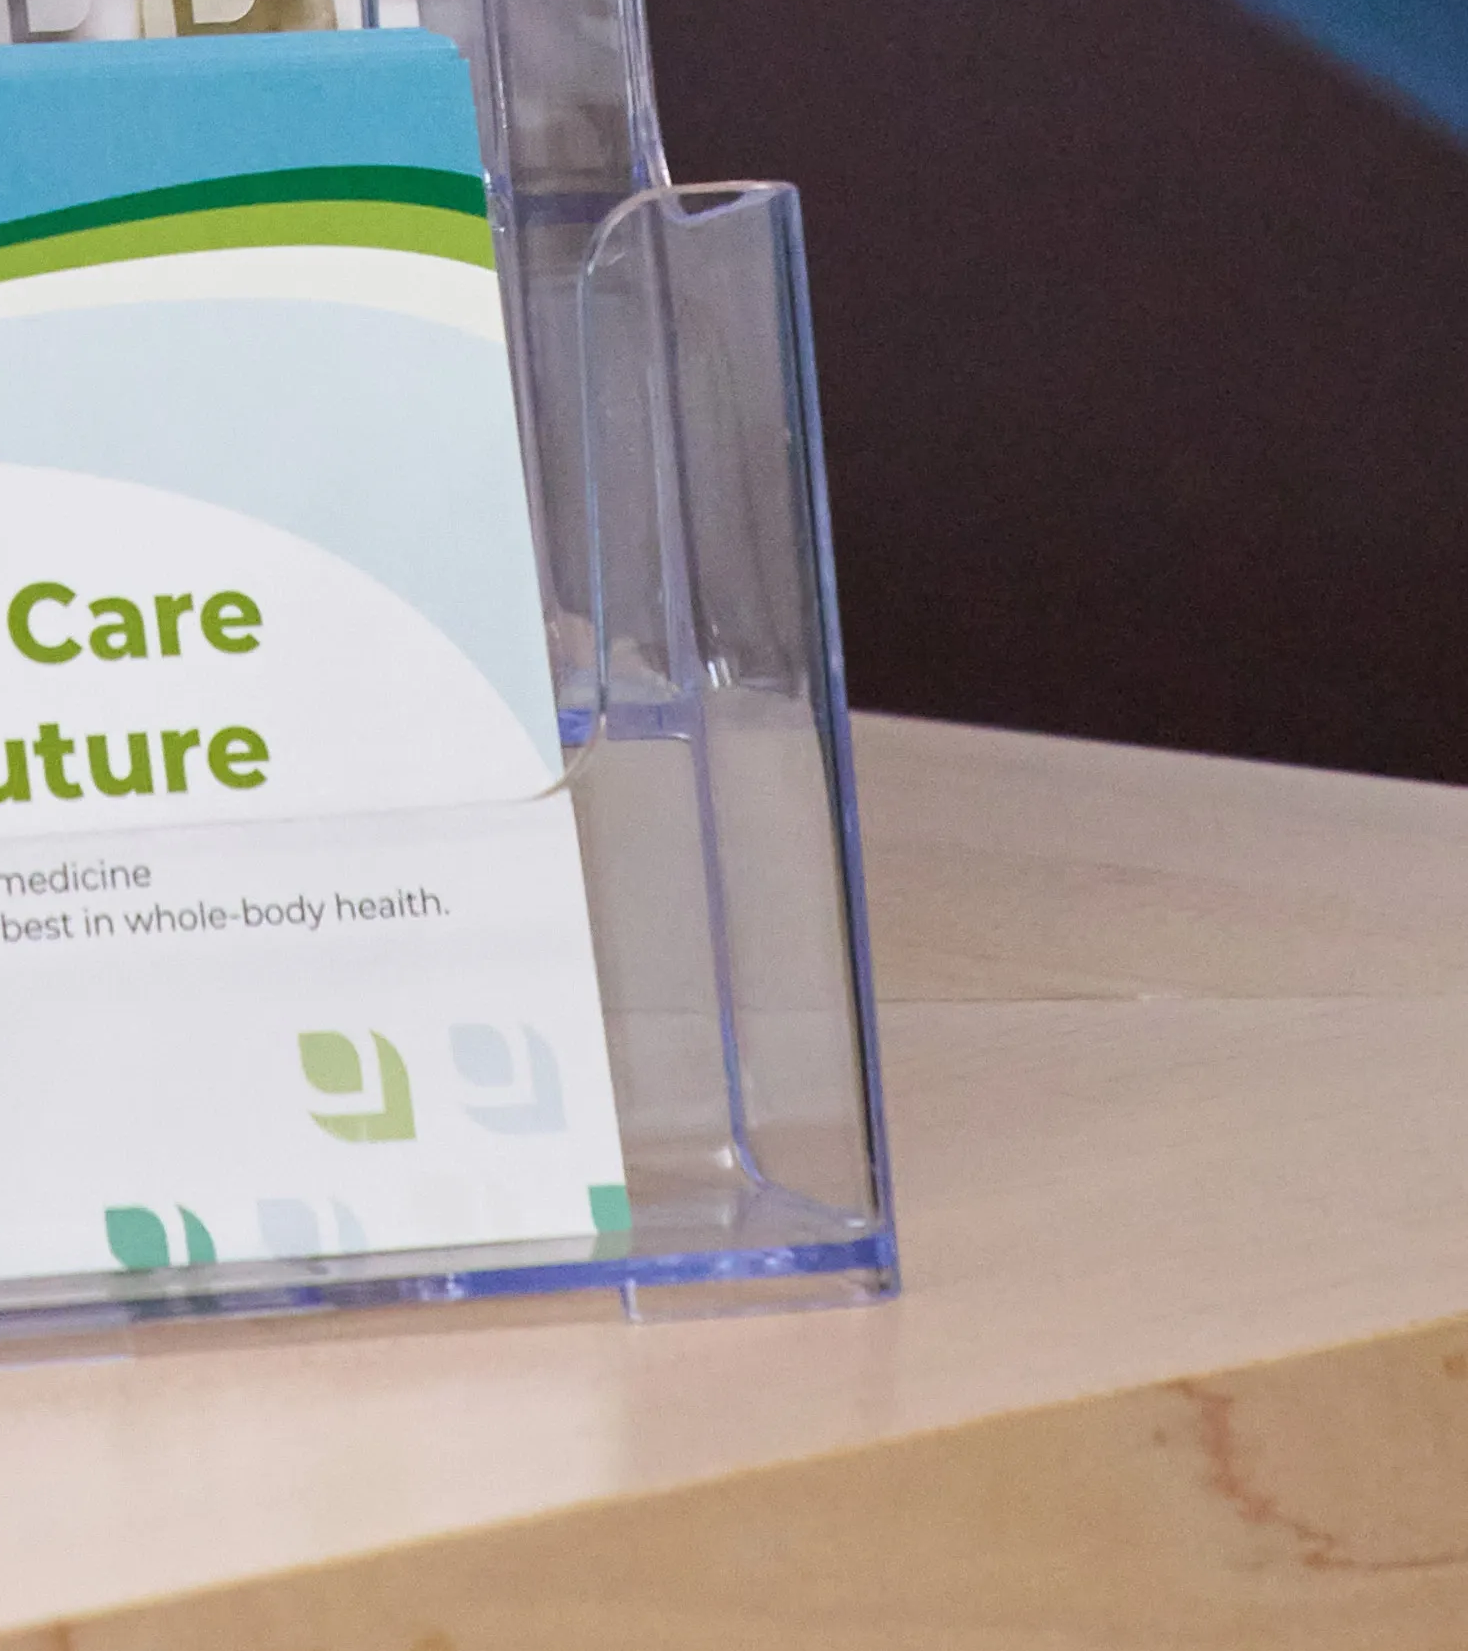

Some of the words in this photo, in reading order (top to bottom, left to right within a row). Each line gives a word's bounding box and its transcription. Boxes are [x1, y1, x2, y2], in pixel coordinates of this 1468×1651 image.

[7, 582, 262, 664] Care
[0, 913, 74, 942] best
[84, 909, 114, 937] in
[124, 895, 325, 934] whole-body
